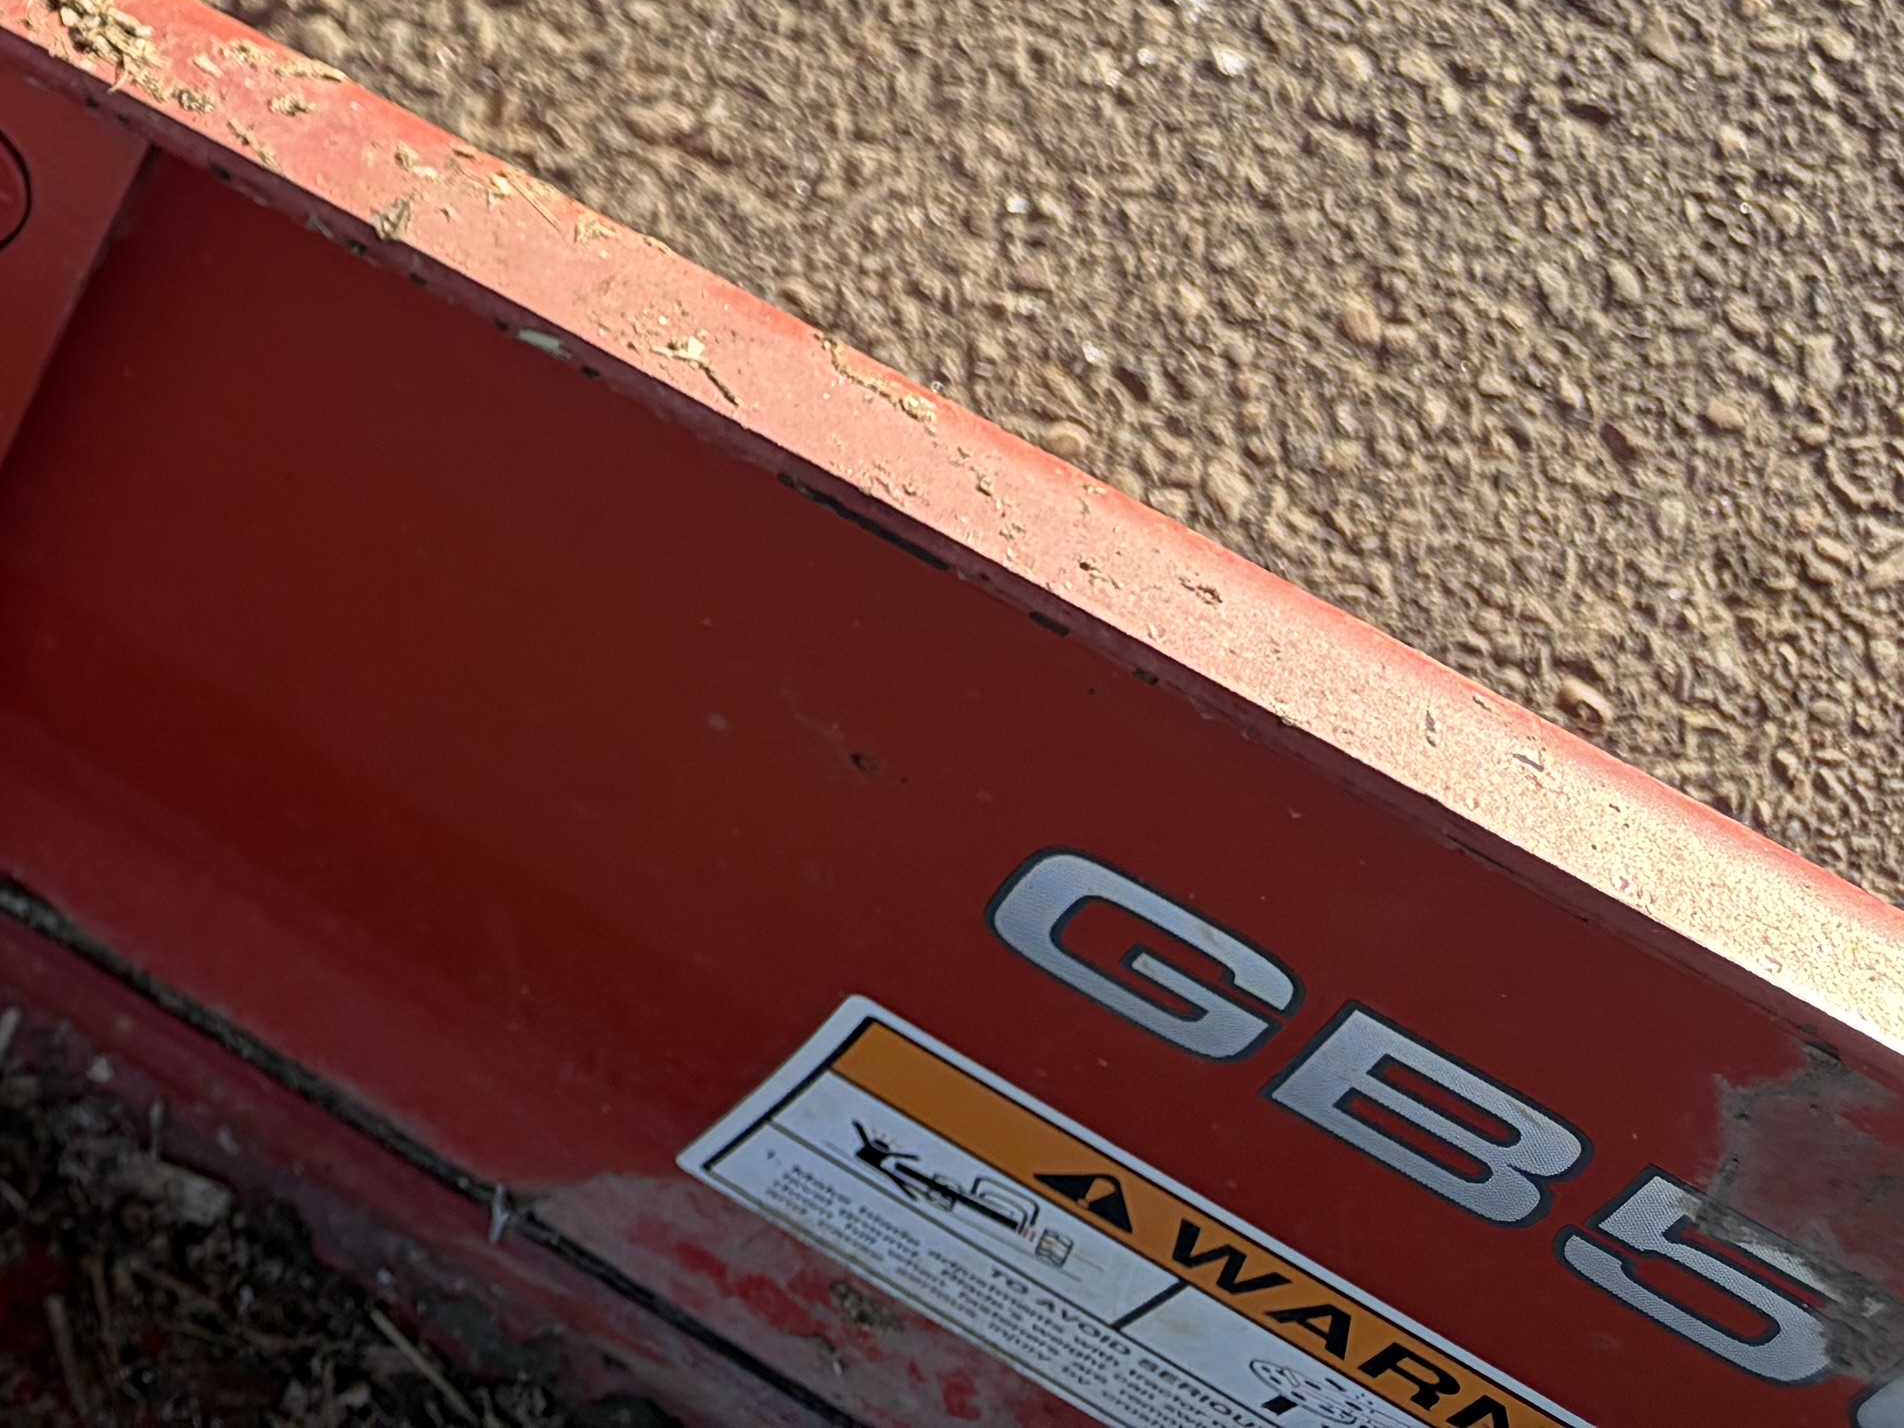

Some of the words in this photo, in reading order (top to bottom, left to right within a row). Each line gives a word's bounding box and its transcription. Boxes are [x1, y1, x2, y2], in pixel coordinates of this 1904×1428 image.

[983, 846, 1904, 1428] GB5
[991, 1267, 1030, 1295] TO
[1035, 1298, 1132, 1356] AVOID
[1138, 1358, 1264, 1428] SERIOU
[1031, 1323, 1107, 1371] weight
[1113, 1373, 1155, 1401] can
[1073, 1335, 1121, 1368] with
